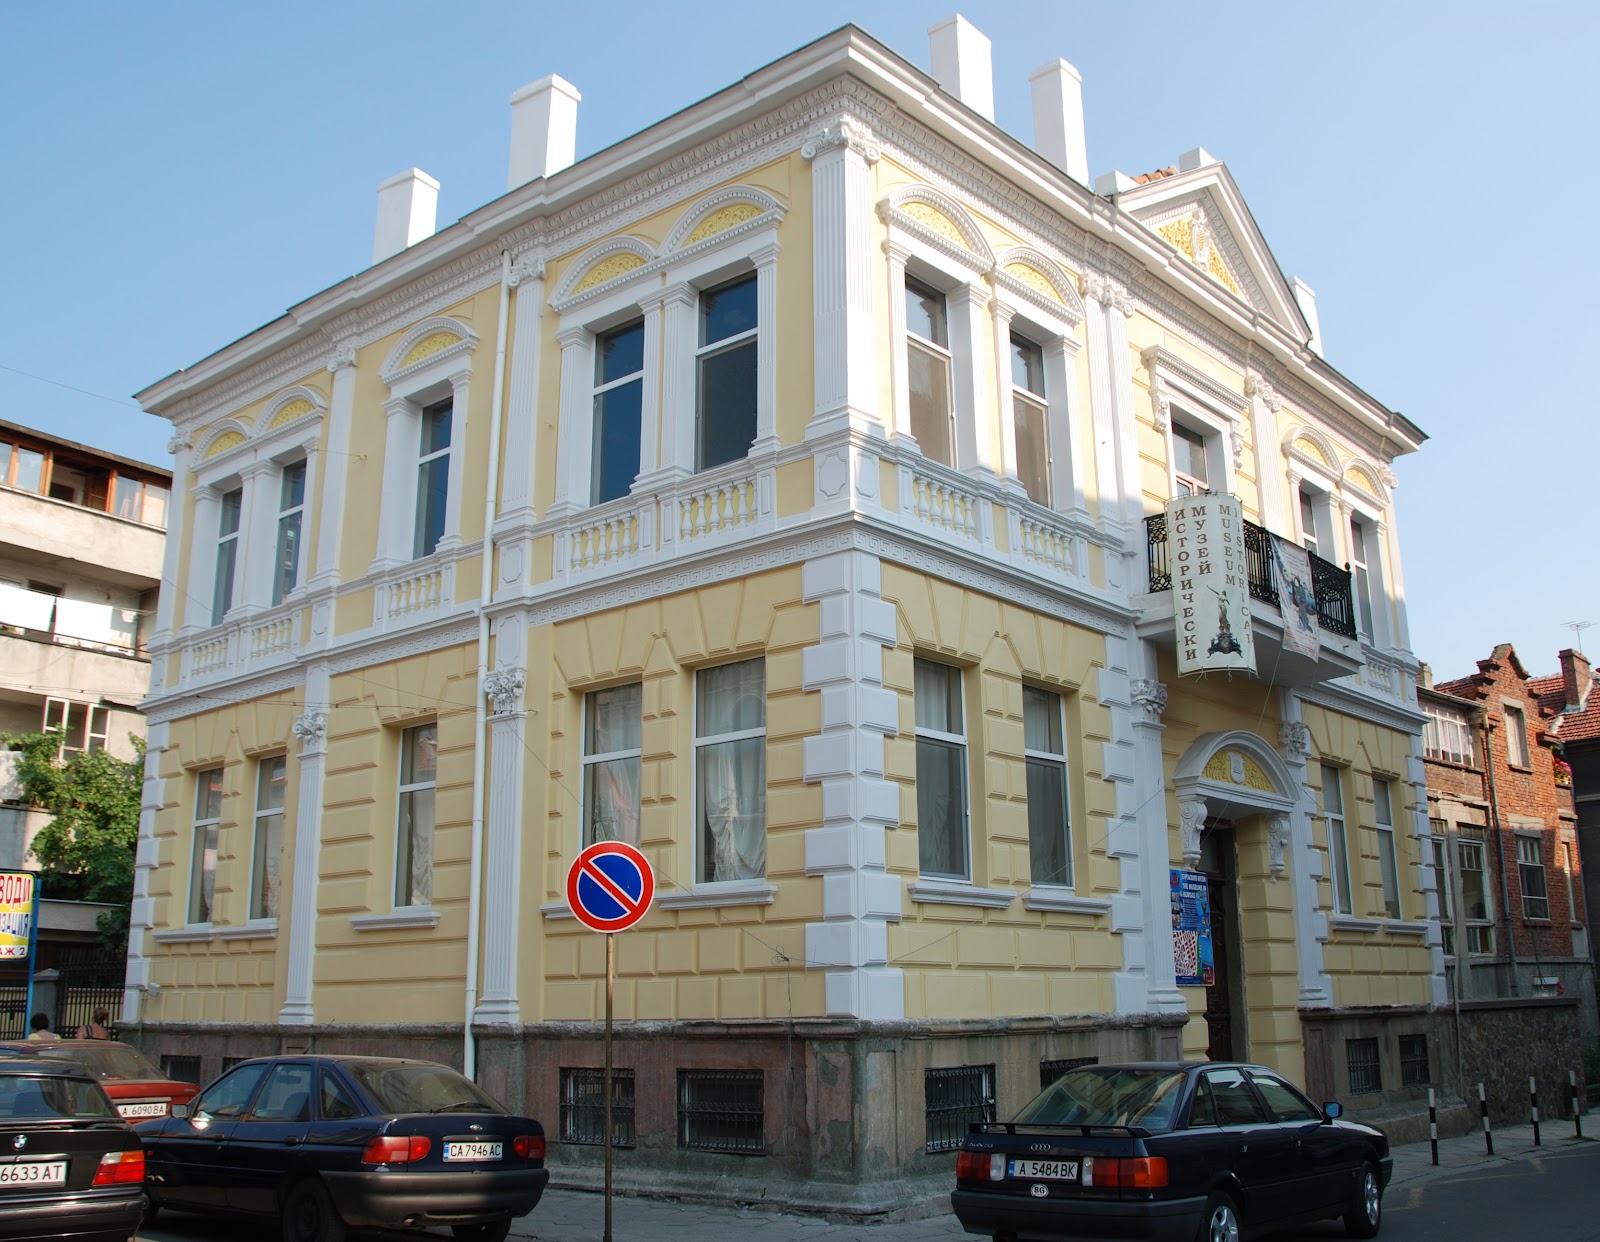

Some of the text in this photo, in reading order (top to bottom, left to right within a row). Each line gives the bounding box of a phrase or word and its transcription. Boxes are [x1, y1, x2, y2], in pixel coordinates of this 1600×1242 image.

[1191, 505, 1211, 575] МУЗЕЙ
[1218, 504, 1236, 586] MUSEUM
[1174, 508, 1197, 661] ИСТОРИЧЕСКИ
[19, 947, 26, 956] 2
